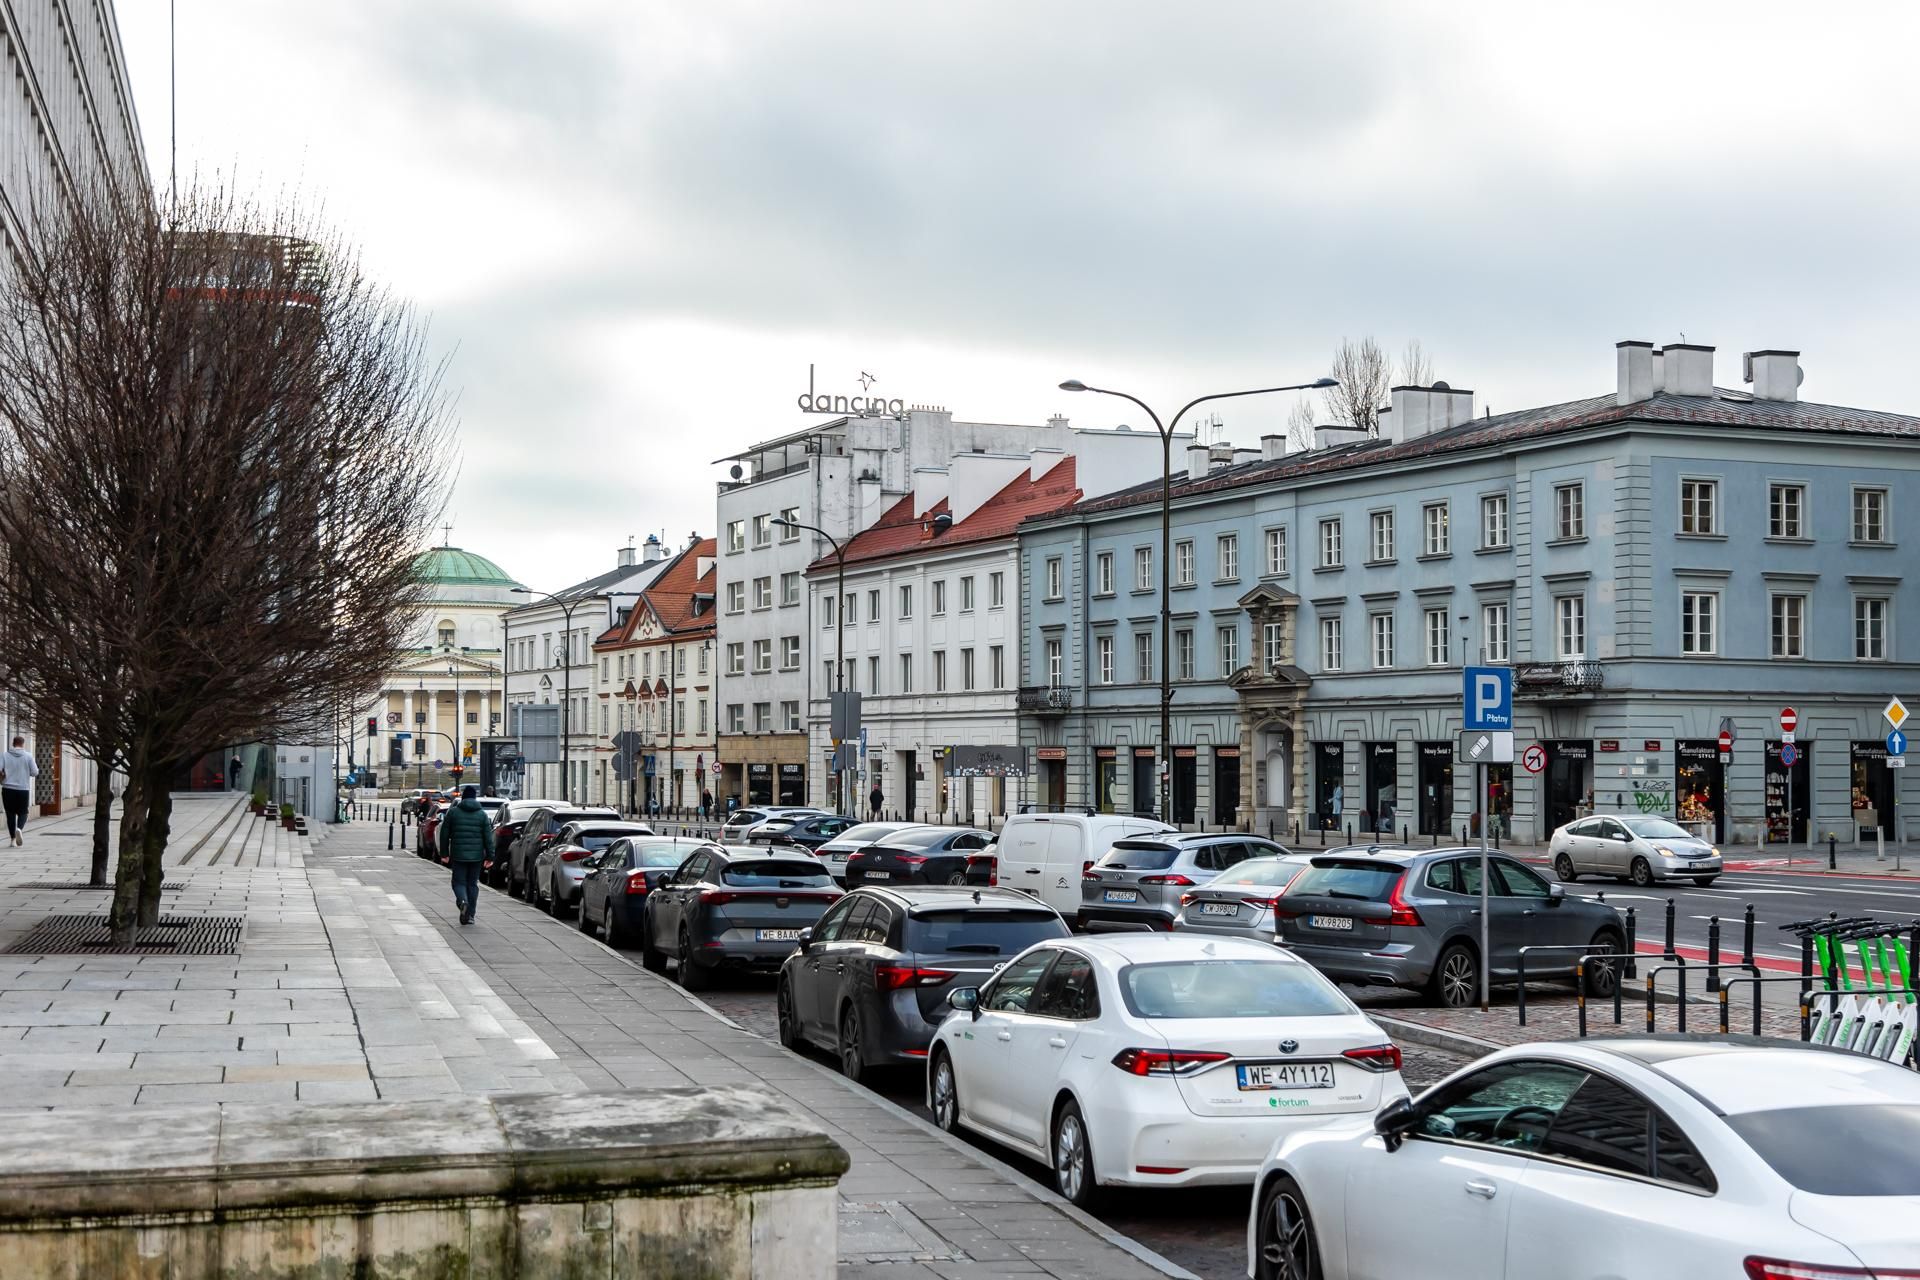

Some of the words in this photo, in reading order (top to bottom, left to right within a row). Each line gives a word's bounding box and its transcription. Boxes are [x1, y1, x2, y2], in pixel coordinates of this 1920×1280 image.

[797, 364, 904, 453] dancing
[1475, 674, 1502, 722] P
[1486, 713, 1509, 725] Płatny
[1424, 747, 1436, 756] Nowy
[1437, 745, 1447, 754] Świat
[752, 764, 767, 772] HUSTLER
[1314, 917, 1325, 926] WX
[1327, 918, 1352, 928] 98205
[763, 930, 774, 939] WE
[777, 930, 800, 940] 8AA0
[1897, 1029, 1913, 1056] Lime
[1250, 1067, 1273, 1084] WE
[1278, 1067, 1330, 1083] 4Y112
[1278, 1096, 1310, 1107] fortum
